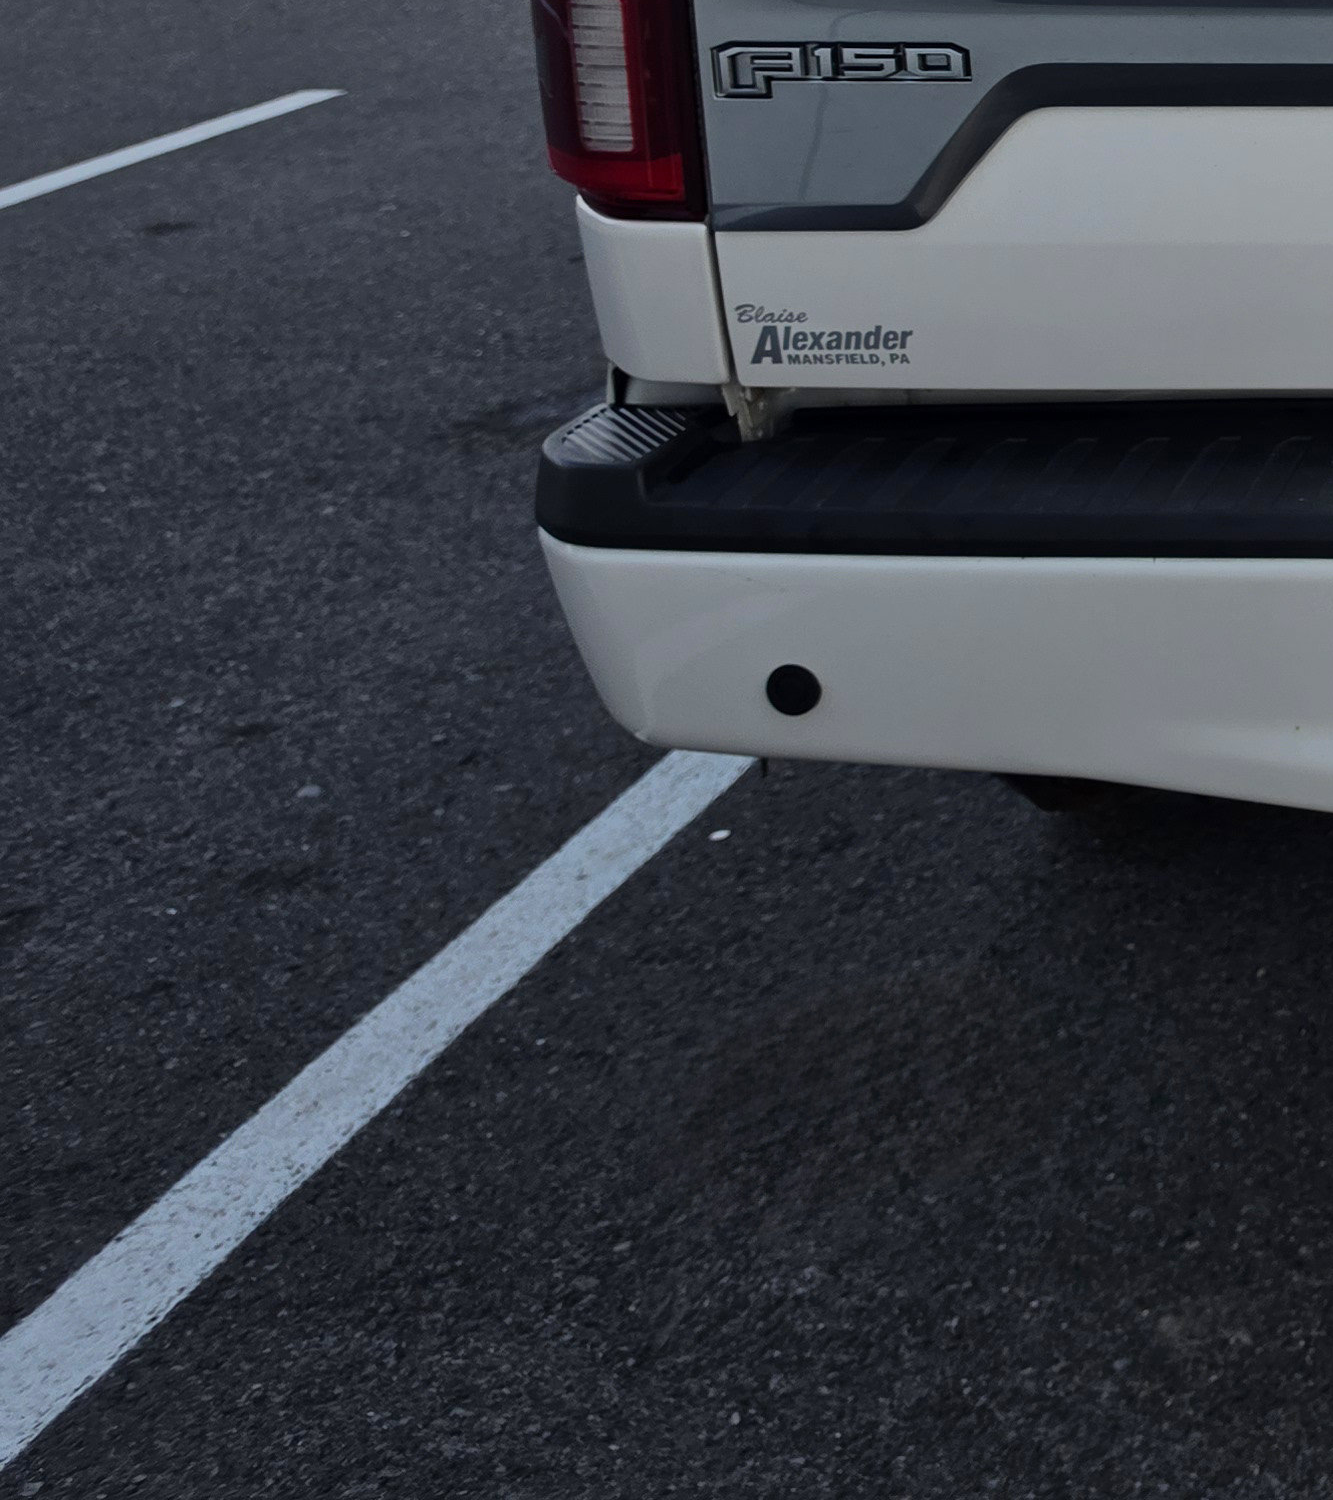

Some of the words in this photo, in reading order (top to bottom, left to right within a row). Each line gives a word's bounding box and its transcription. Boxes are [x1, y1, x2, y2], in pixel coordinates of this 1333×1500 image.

[734, 303, 808, 323] Blaise
[750, 325, 913, 365] Alexander
[787, 353, 886, 367] MANSFIELD,
[890, 353, 911, 365] PA
